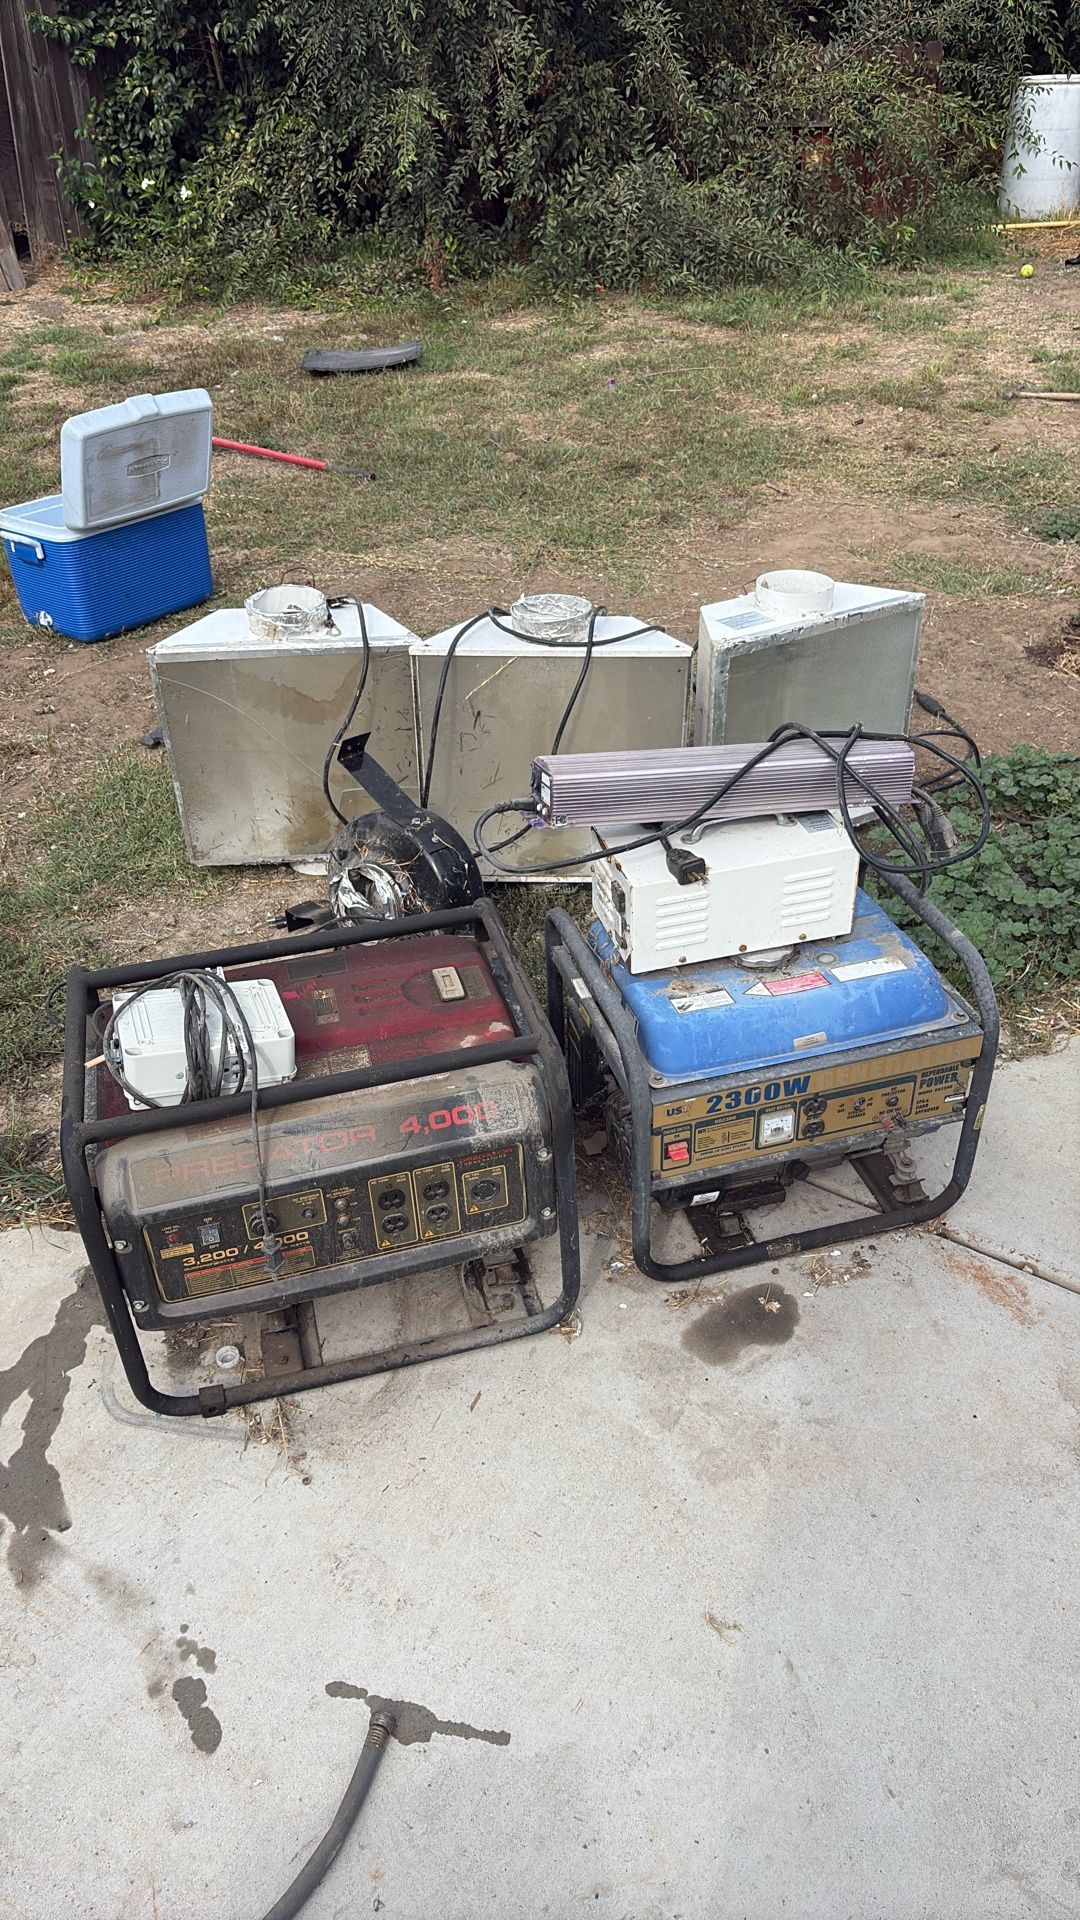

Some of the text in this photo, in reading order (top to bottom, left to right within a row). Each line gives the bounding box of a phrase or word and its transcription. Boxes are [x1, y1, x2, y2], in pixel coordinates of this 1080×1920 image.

[919, 1072, 958, 1089] POWER
[921, 1064, 960, 1078] DEPENDABLE
[706, 1075, 811, 1114] 2300W
[155, 1101, 497, 1186] PREDATOR 4,000
[182, 1247, 239, 1268] 3,200
[243, 1244, 249, 1254] /
[253, 1231, 309, 1251] 400
